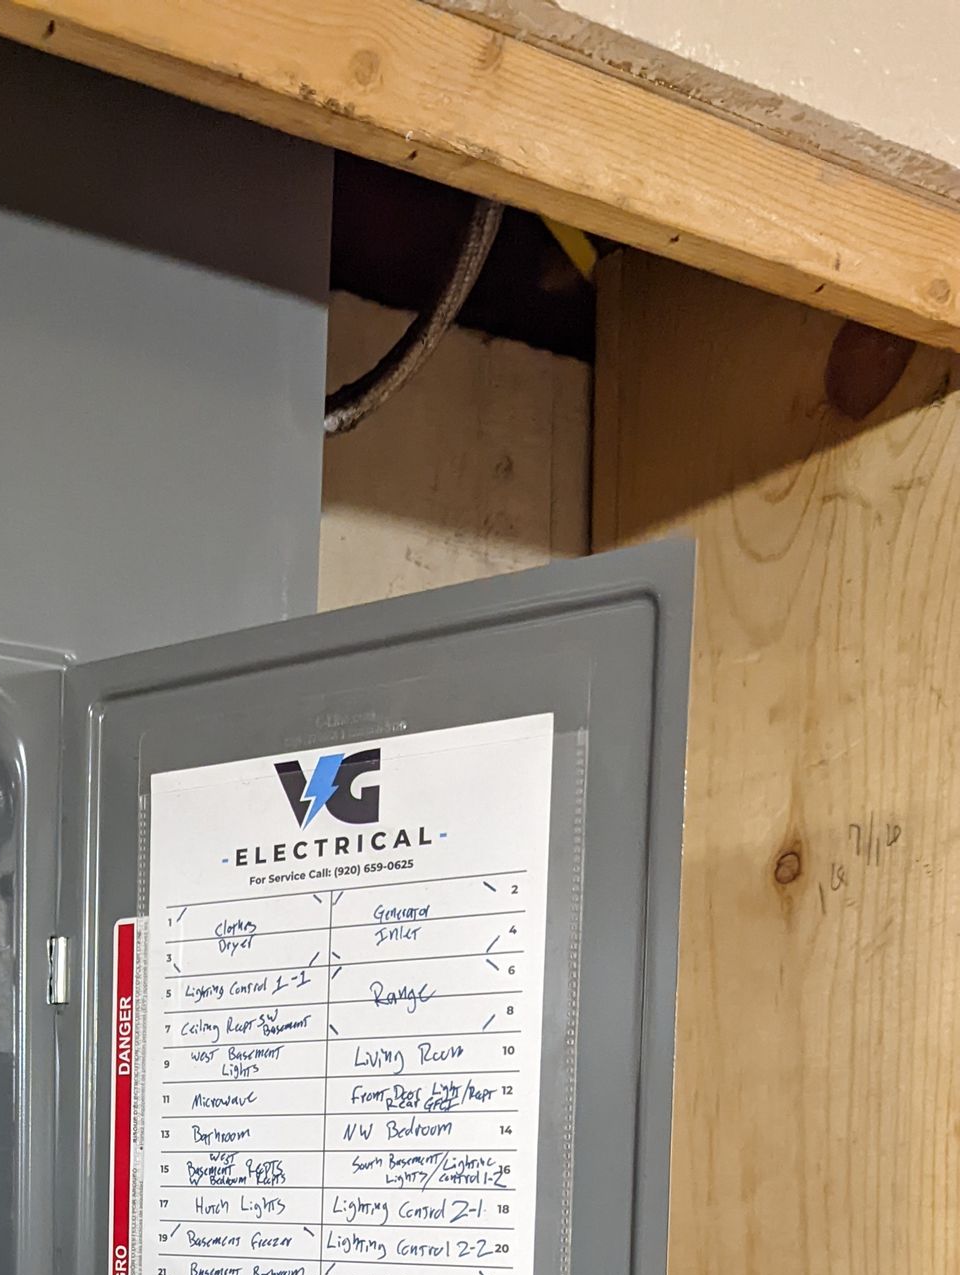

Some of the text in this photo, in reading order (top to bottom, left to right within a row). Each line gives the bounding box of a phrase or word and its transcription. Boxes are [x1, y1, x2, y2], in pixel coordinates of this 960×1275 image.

[235, 826, 433, 866] ELECTRICAL
[249, 858, 415, 886] For Service Call: (920) 659-0625
[511, 885, 519, 894] 2
[168, 918, 172, 927] 1
[509, 925, 517, 934] 4
[218, 936, 254, 957] Dryer
[166, 953, 172, 963] 3
[508, 965, 516, 975] 6
[166, 989, 172, 998] 5
[370, 981, 437, 1013] Range
[506, 1006, 514, 1015] 8
[164, 1024, 171, 1033] 7
[118, 996, 132, 1075] DANGER
[502, 1046, 515, 1055] 10
[163, 1060, 170, 1069] 9
[354, 1045, 404, 1075] Living
[502, 1086, 513, 1095] 12
[163, 1095, 170, 1104] 11
[191, 1091, 258, 1110] Microwave
[386, 1116, 453, 1140] Bedroom
[500, 1126, 512, 1135] 14
[161, 1130, 170, 1139] 13
[191, 1125, 250, 1145] Bathroom
[160, 1165, 170, 1173] 15
[159, 1199, 169, 1208] 17
[240, 1195, 286, 1219] Lights
[498, 1204, 510, 1214] 18
[158, 1233, 168, 1242] 19
[494, 1244, 509, 1253] 20
[158, 1268, 166, 1275] 21
